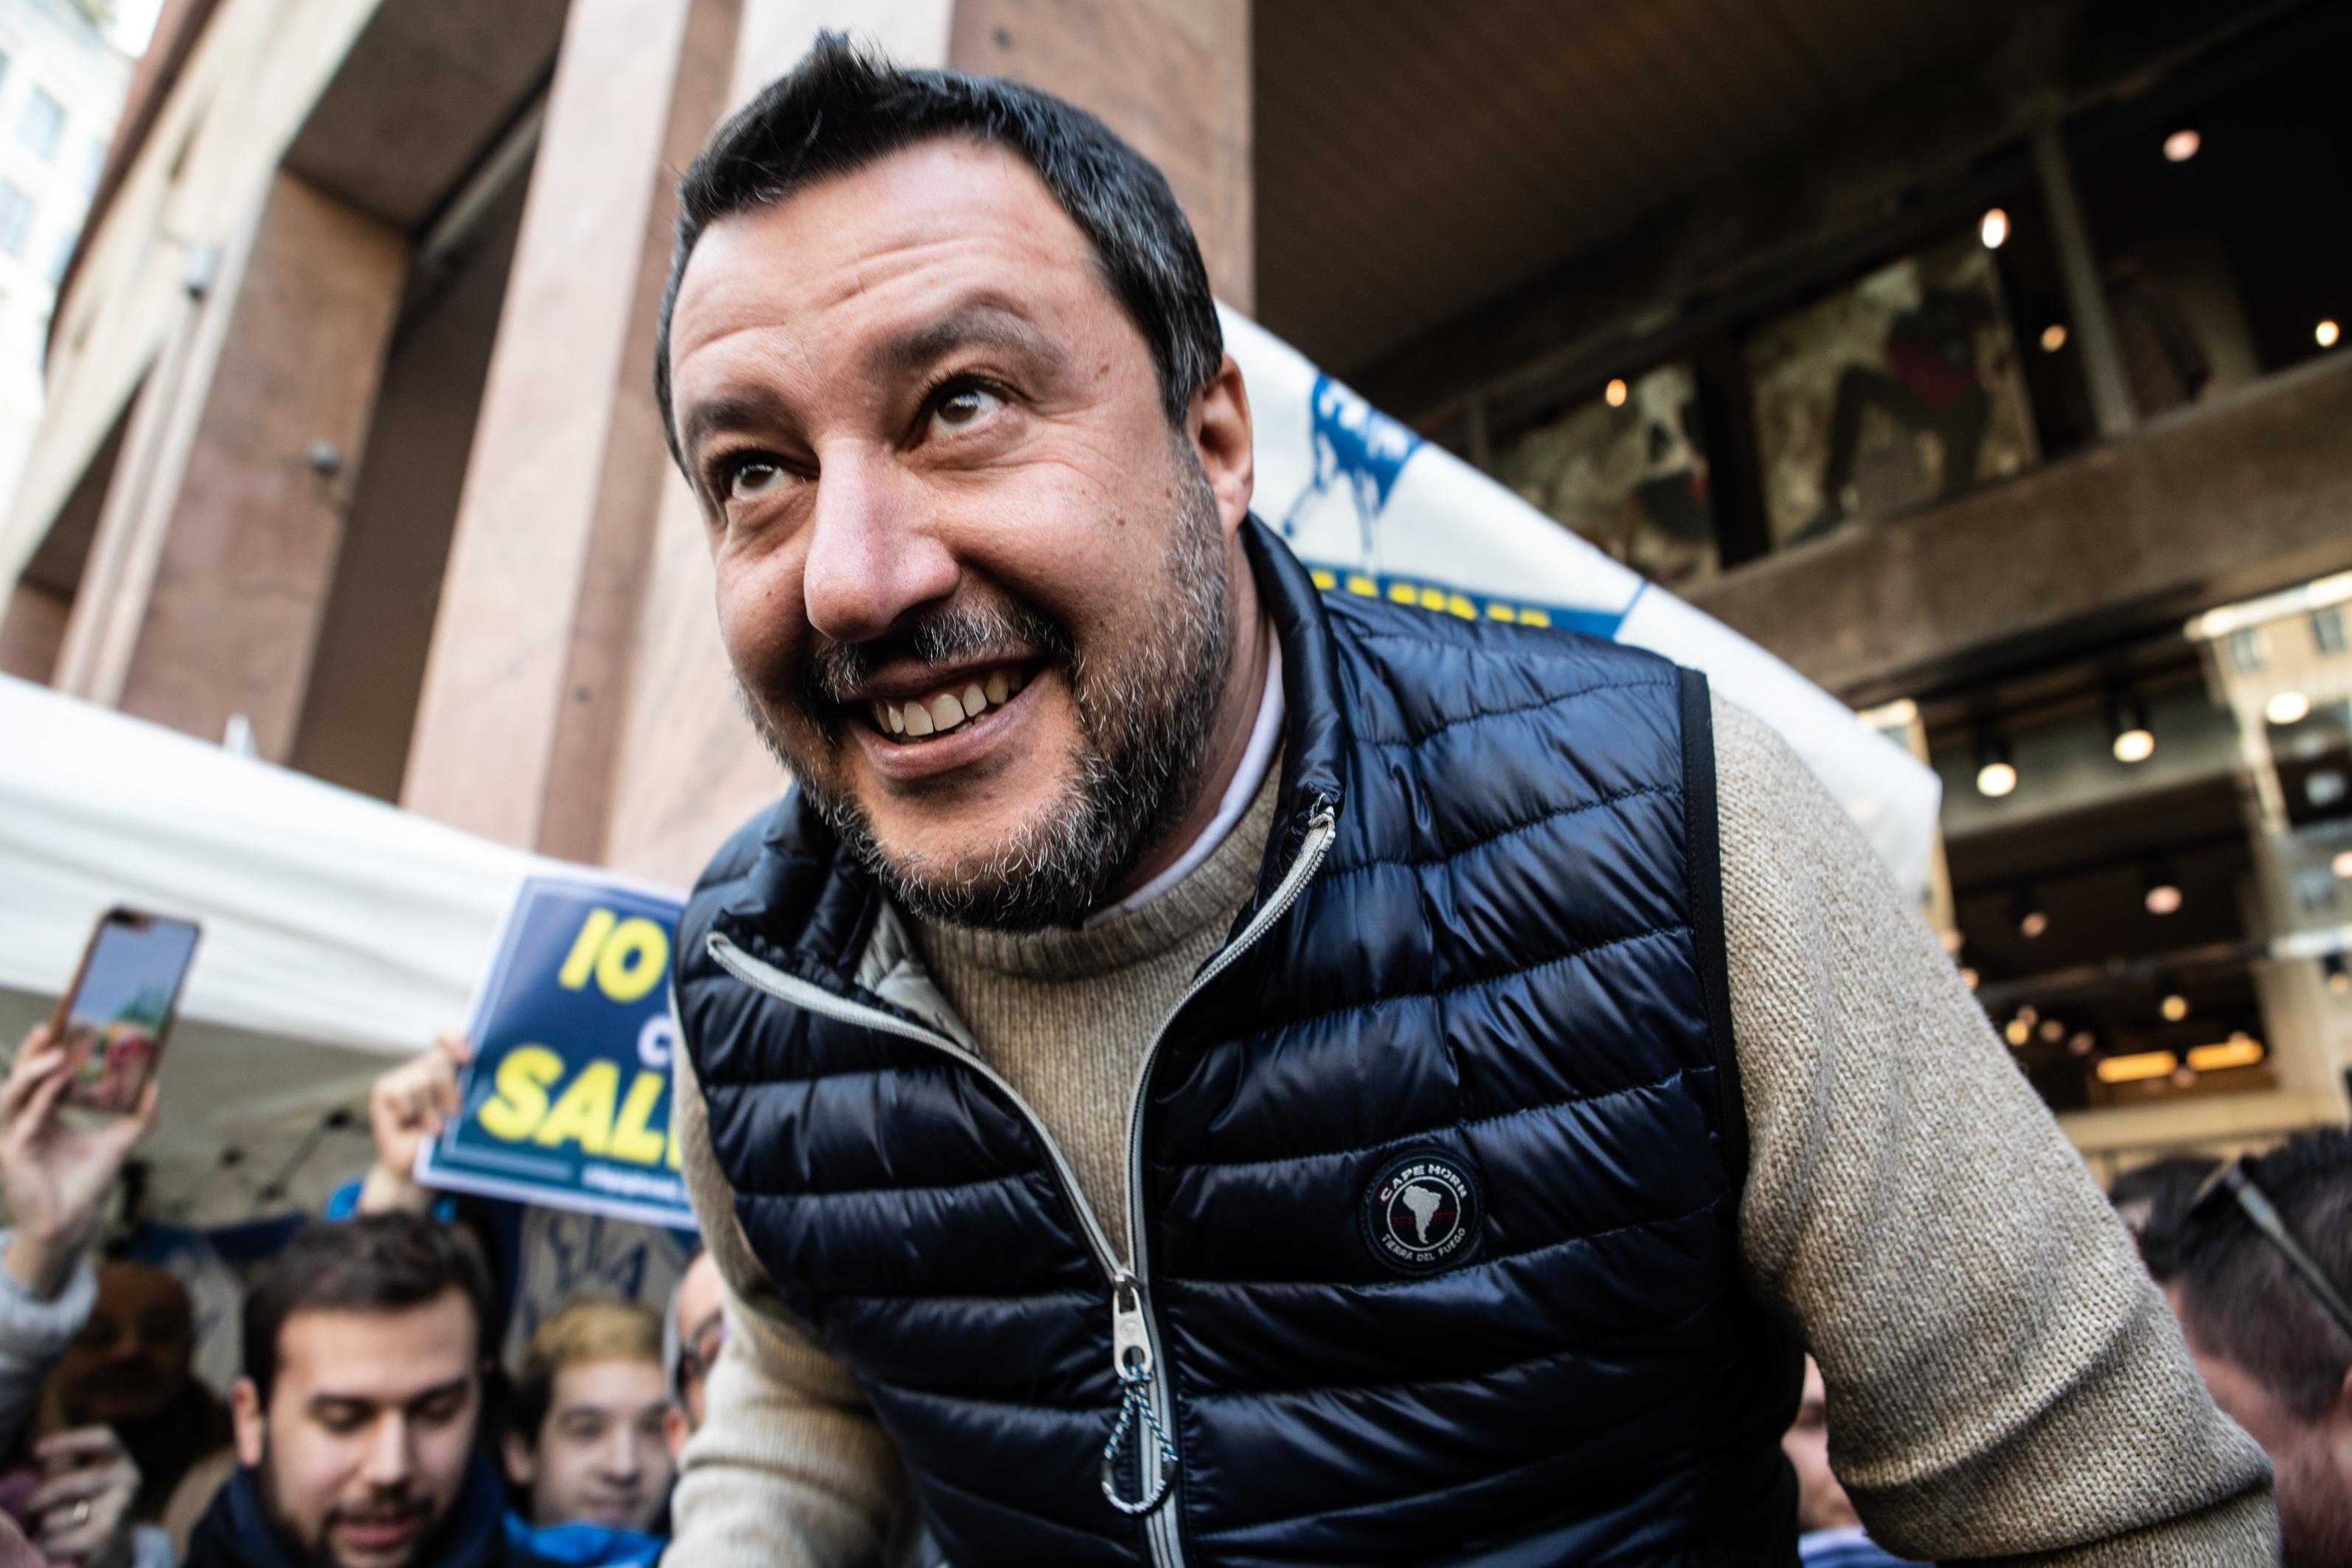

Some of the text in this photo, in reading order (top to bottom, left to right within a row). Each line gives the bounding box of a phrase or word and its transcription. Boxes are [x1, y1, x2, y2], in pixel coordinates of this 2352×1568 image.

[1380, 1164, 1468, 1202] CAPE HORN
[1381, 1227, 1466, 1262] TIERRA DEL FUEGO
